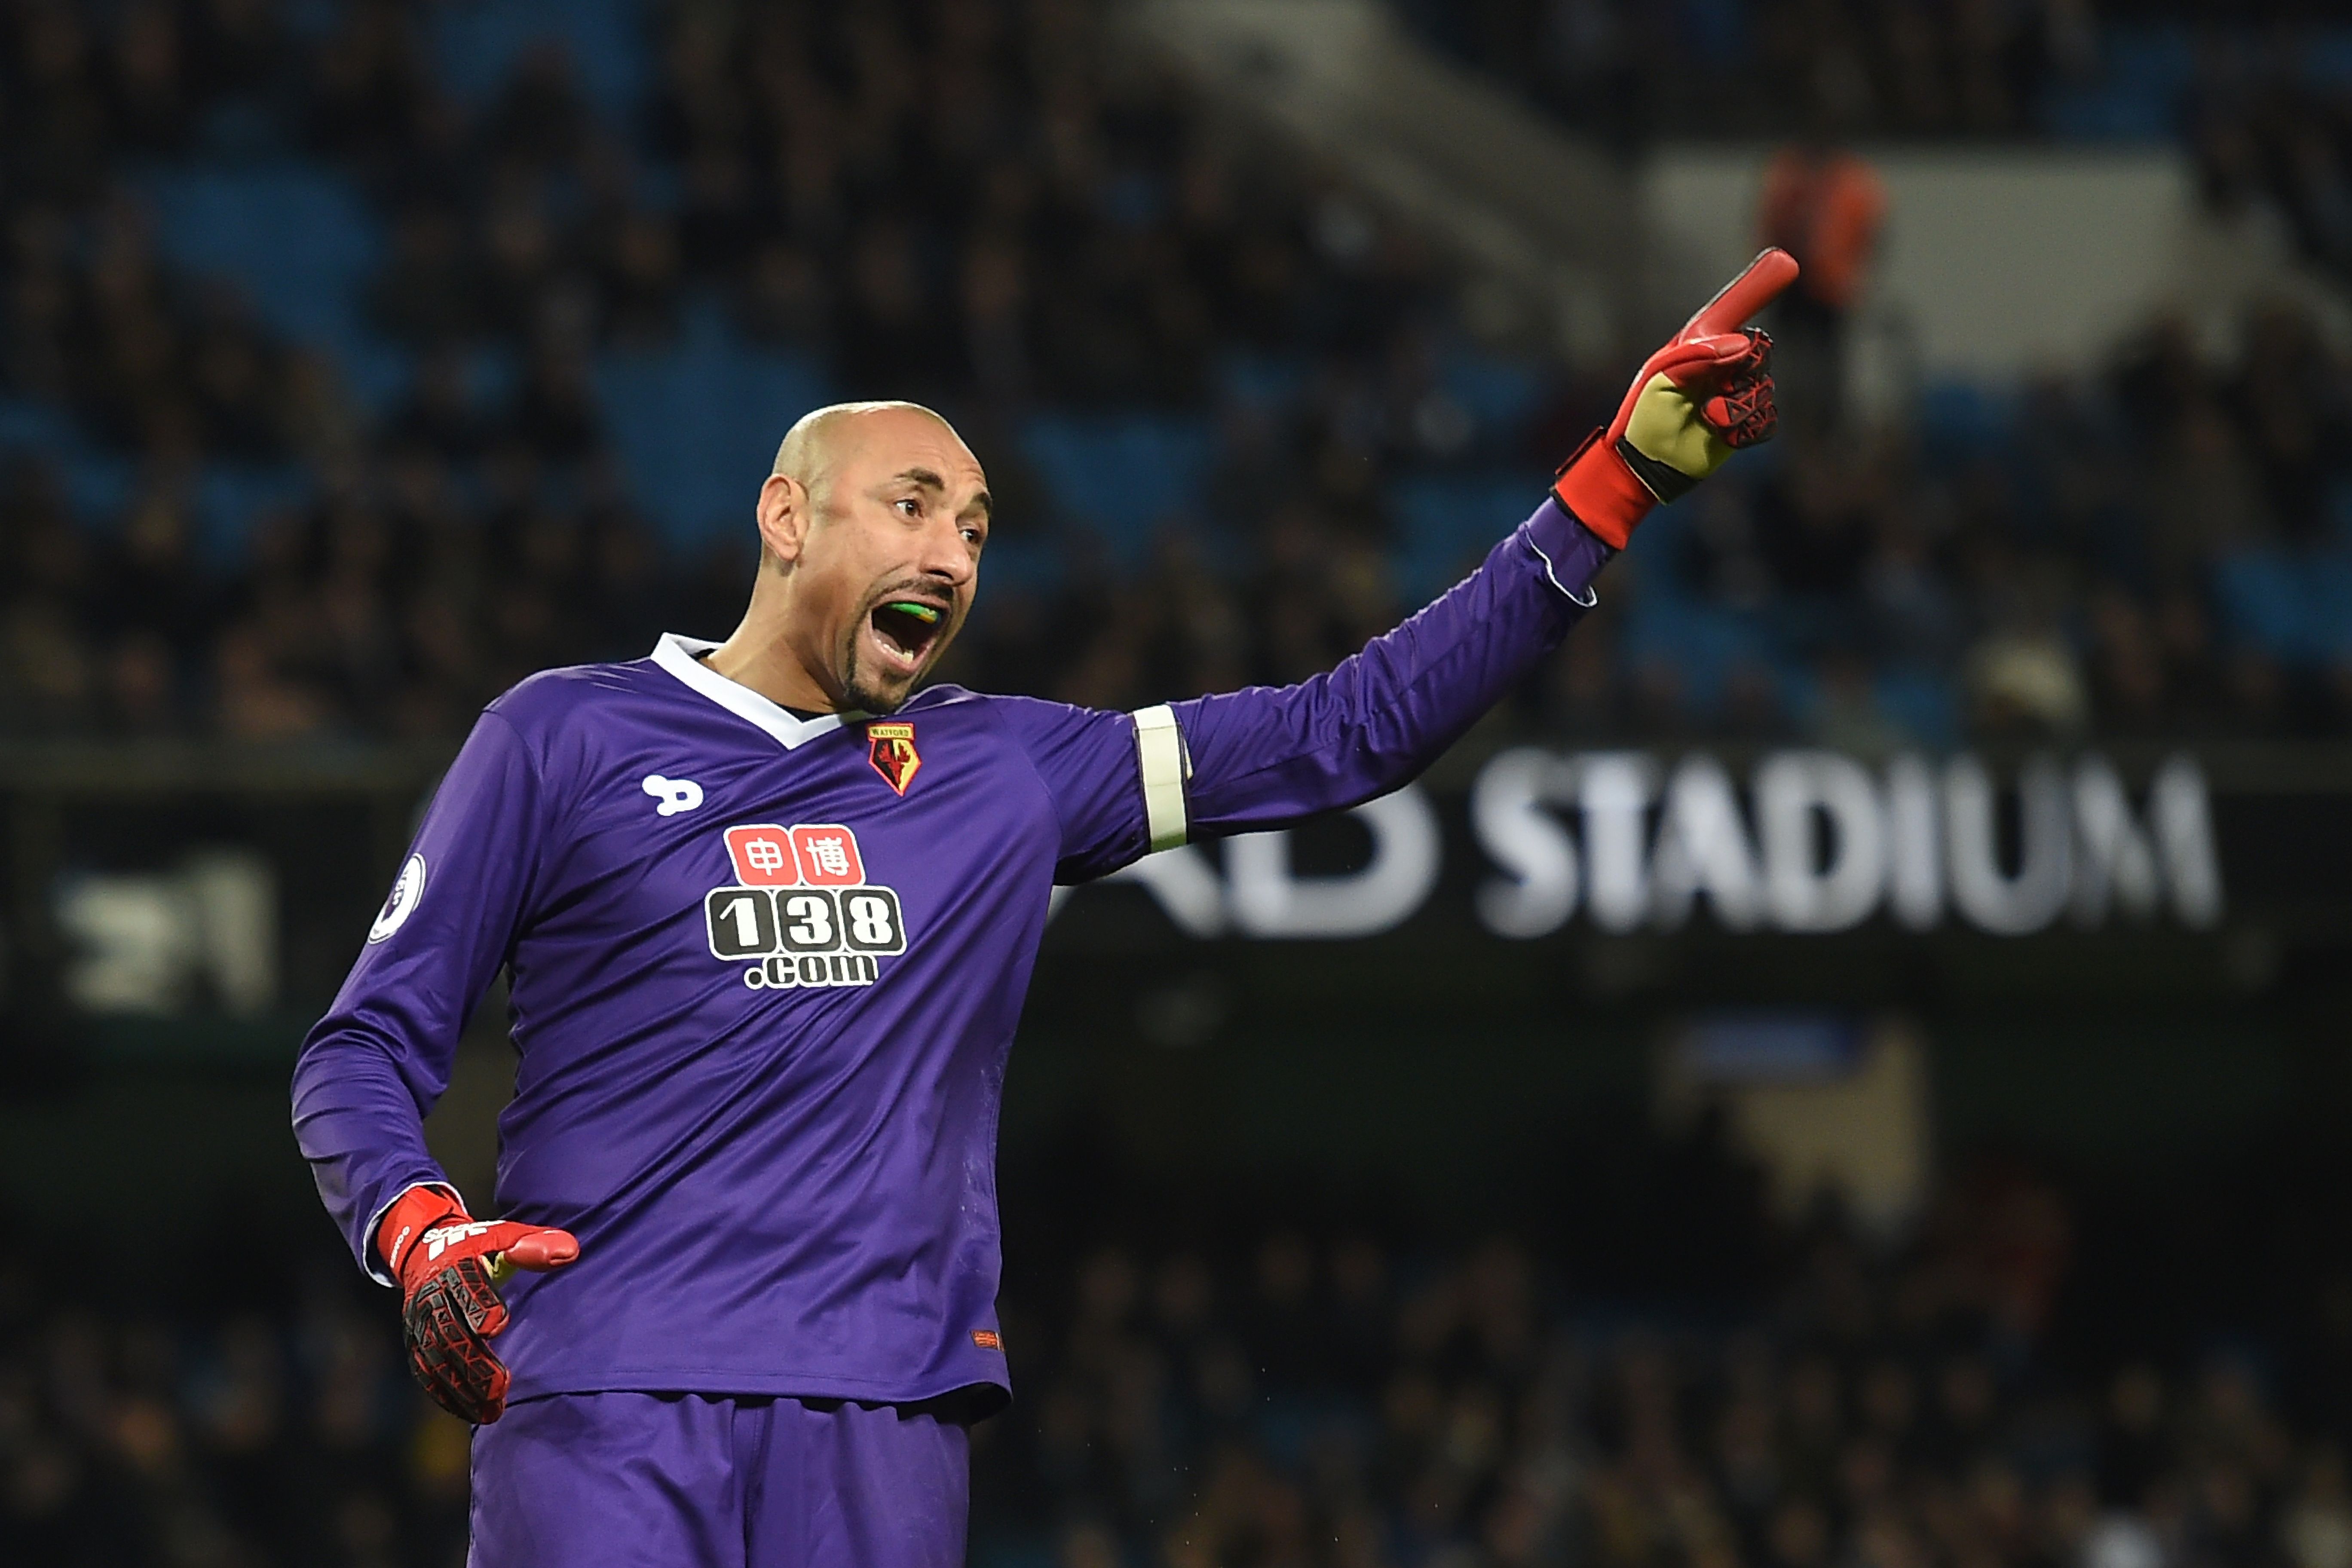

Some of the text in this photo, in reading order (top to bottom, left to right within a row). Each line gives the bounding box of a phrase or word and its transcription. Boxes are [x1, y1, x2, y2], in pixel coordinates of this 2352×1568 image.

[745, 836, 850, 876] 申博
[1472, 747, 2223, 938] STADIUM
[719, 896, 894, 947] 138
[747, 955, 877, 986] .com
